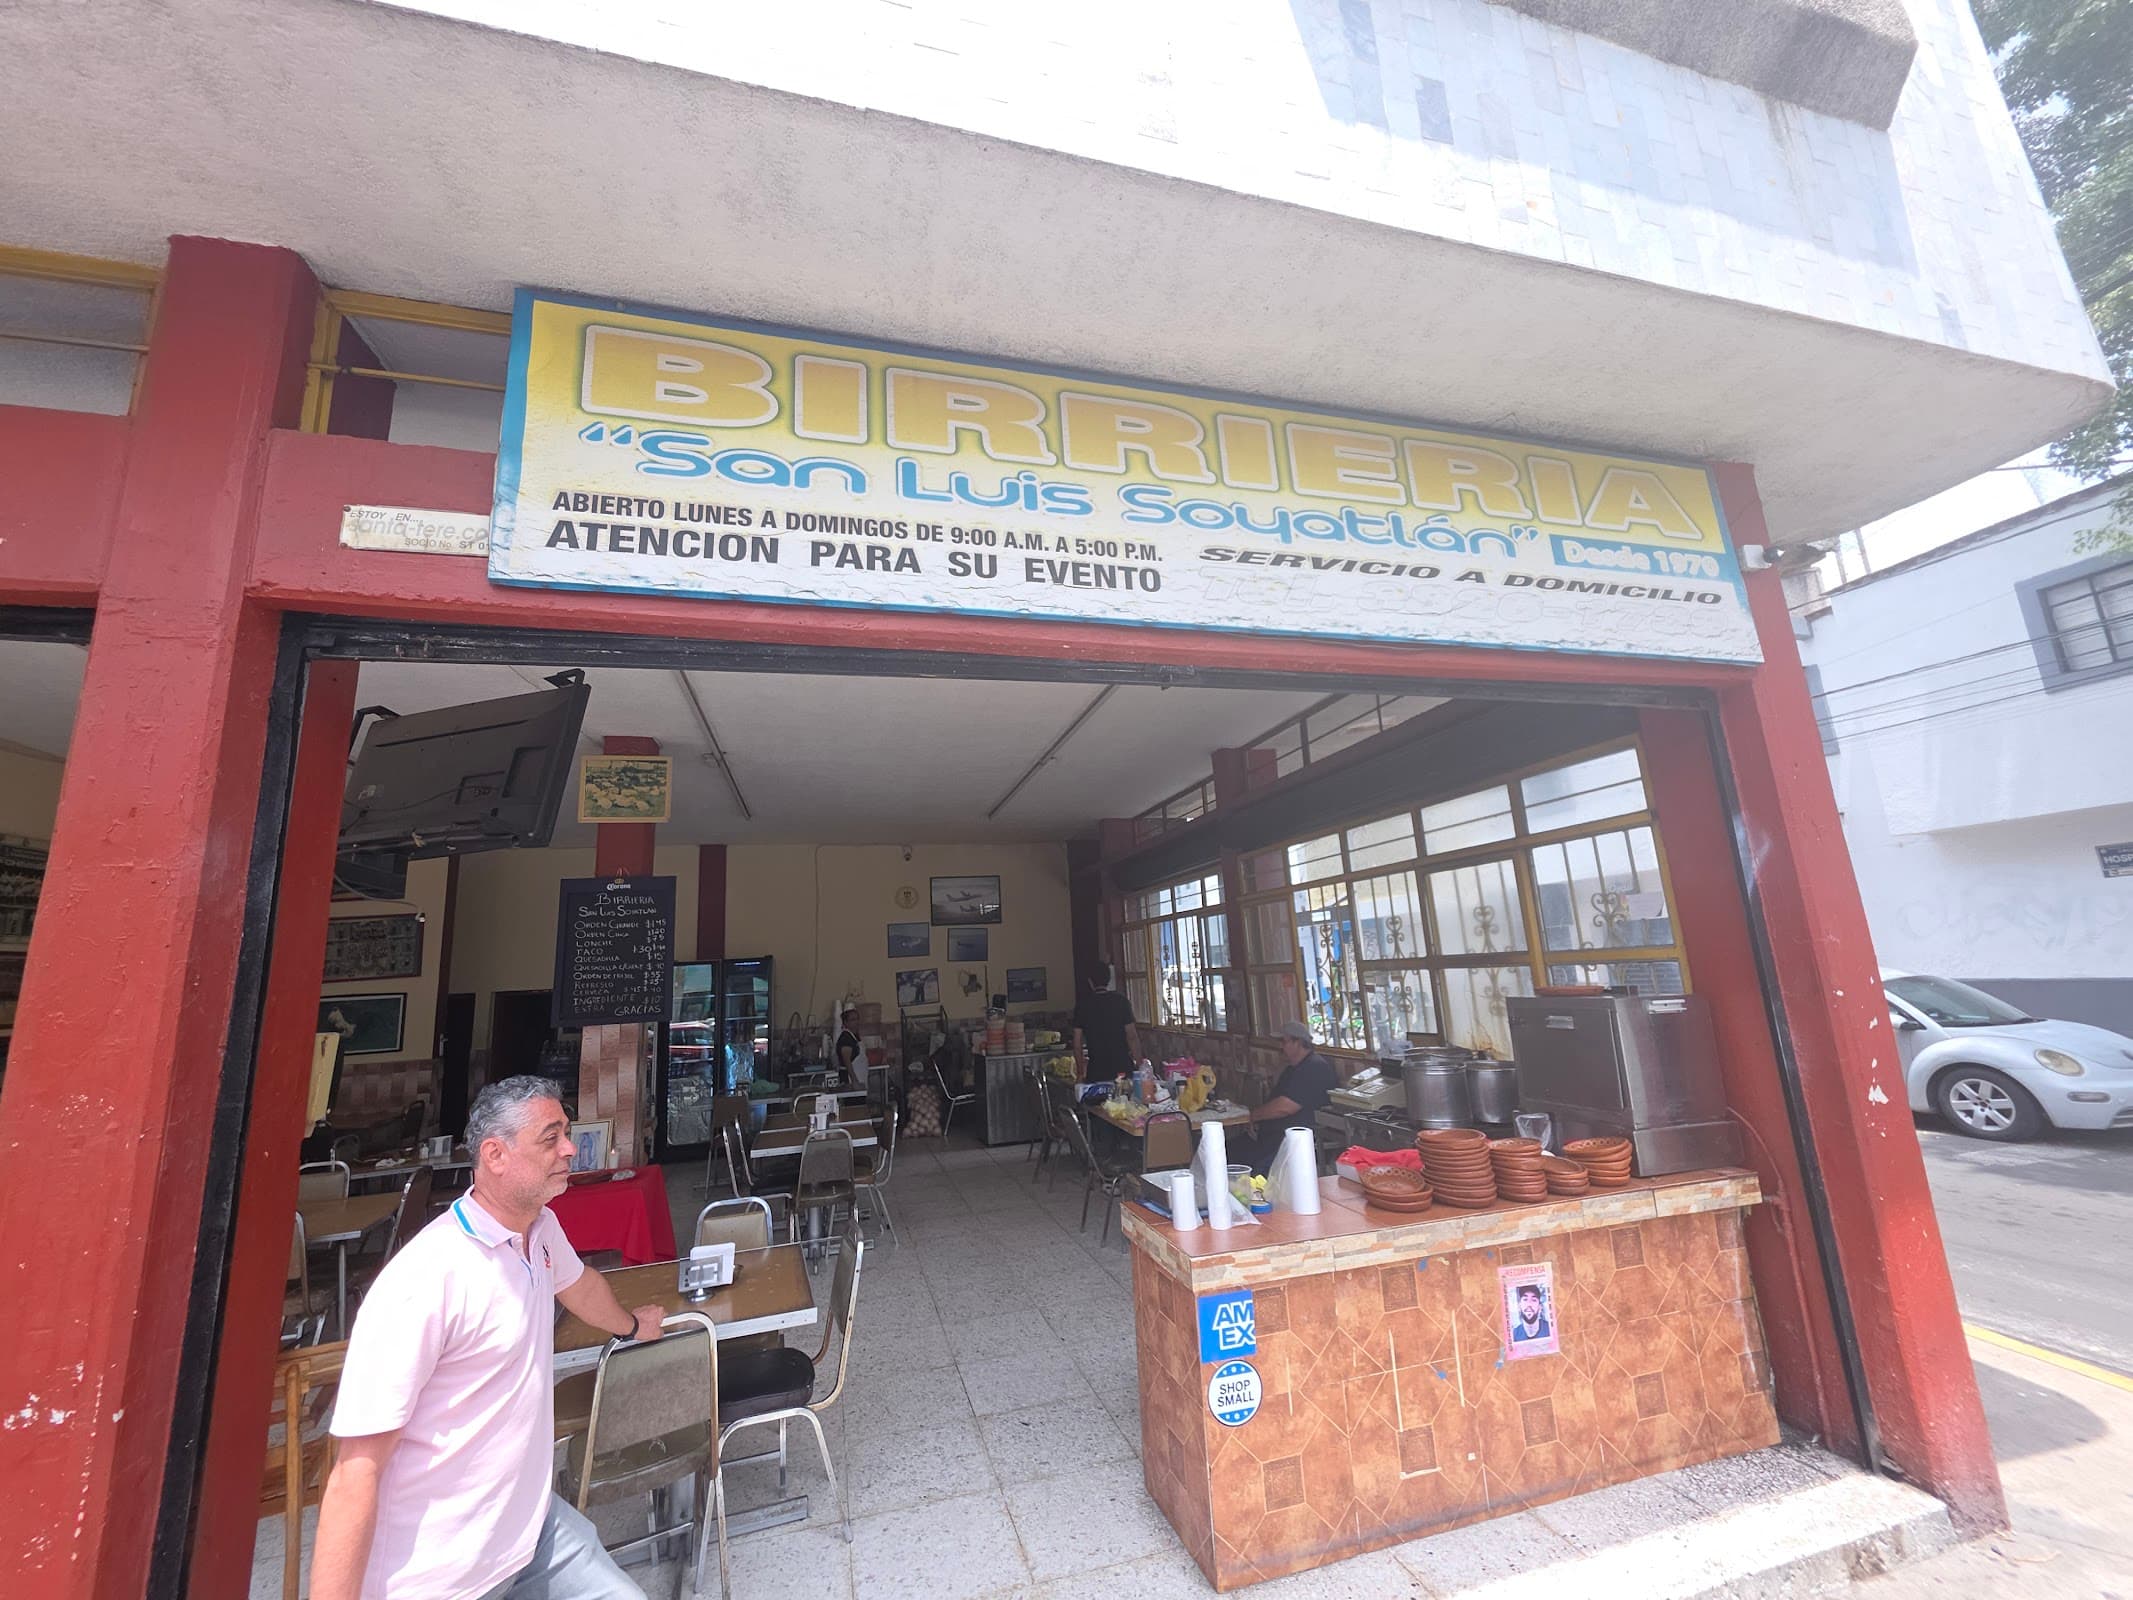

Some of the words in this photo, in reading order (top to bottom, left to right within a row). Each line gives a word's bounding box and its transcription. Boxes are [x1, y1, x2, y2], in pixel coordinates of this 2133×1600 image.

[580, 325, 1703, 541] BIRRIERIA
[896, 457, 1095, 516] Luis
[350, 510, 387, 520] ESTOY
[552, 491, 666, 520] ABIERTO
[673, 502, 753, 530] LUNES
[761, 510, 779, 530] A
[784, 512, 909, 541] DOMINGOS
[915, 521, 945, 543] DE
[949, 525, 998, 548] 9:00
[1003, 528, 1050, 553] A.M.
[1055, 532, 1072, 554] A
[1074, 535, 1119, 559] 5:00
[1124, 541, 1163, 562] P.M.
[459, 540, 475, 549] ST
[546, 519, 780, 564] ATENCION
[810, 541, 922, 575] PARA
[948, 551, 999, 580] SU
[1024, 556, 1161, 594] EVENTO
[1561, 540, 1650, 570] Desde
[1653, 551, 1720, 578] 1970
[1200, 547, 1441, 579] SERVICIO
[1455, 571, 1486, 584] A
[1504, 574, 1722, 605] DOMICILIO
[577, 948, 604, 957] TACO
[614, 1005, 662, 1016] GRACIAS
[1212, 1300, 1255, 1330] AM
[1219, 1324, 1256, 1351] EX
[1217, 1391, 1255, 1408] SMALL
[1219, 1379, 1251, 1395] SHOP
